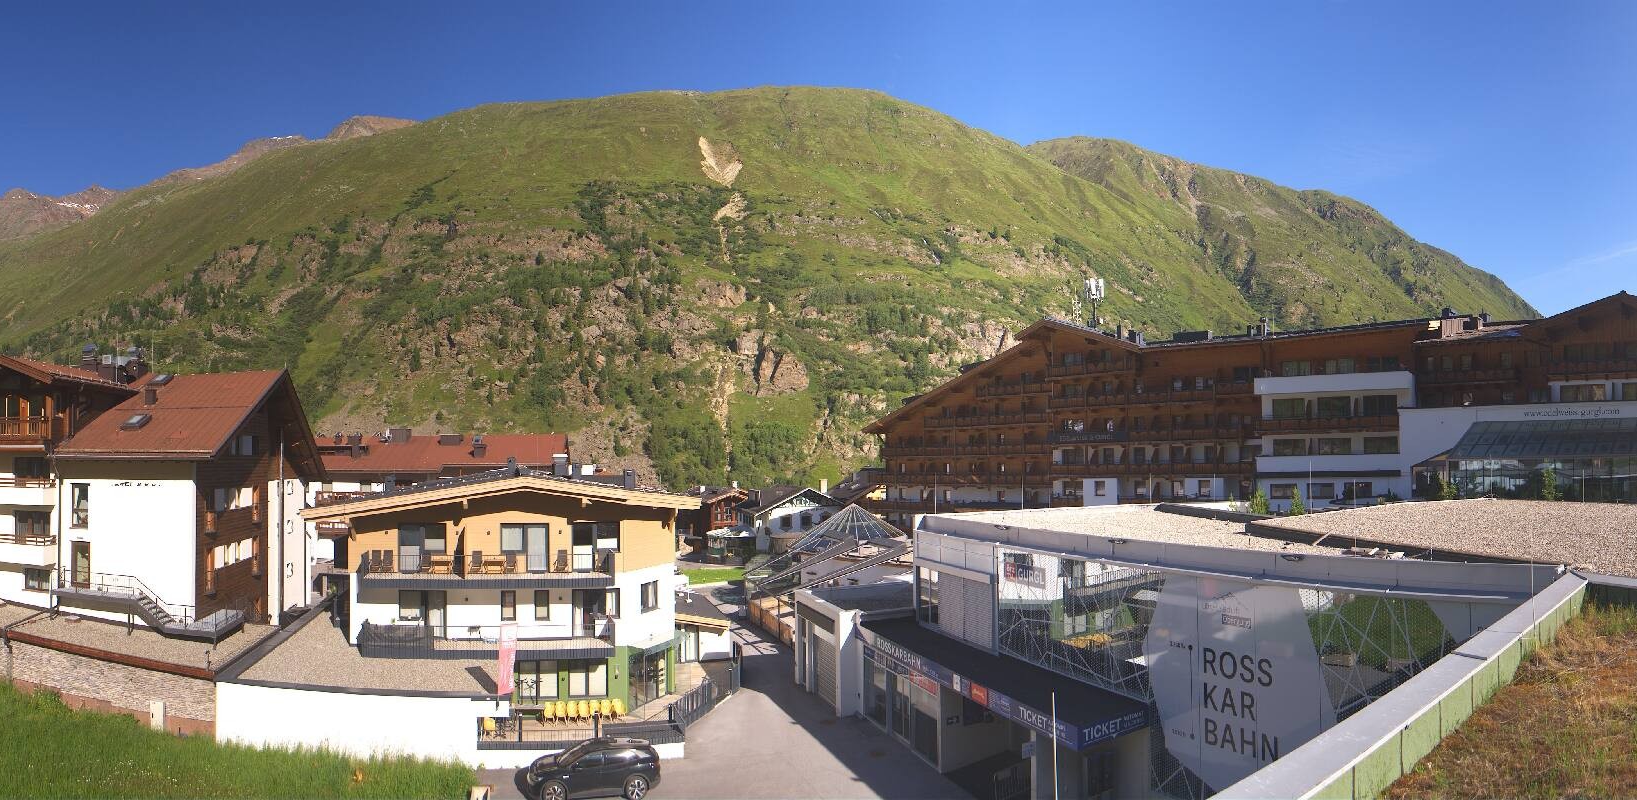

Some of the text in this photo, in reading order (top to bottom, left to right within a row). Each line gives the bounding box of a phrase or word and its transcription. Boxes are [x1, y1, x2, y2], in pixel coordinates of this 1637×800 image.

[1017, 567, 1045, 585] GURGL
[876, 637, 921, 670] ROSSKARBAHN
[1203, 647, 1273, 687] ROSS
[1019, 706, 1048, 729] TICKET
[1203, 682, 1256, 721] KAR
[1083, 718, 1122, 741] TICKET
[1204, 717, 1279, 762] BAHN
